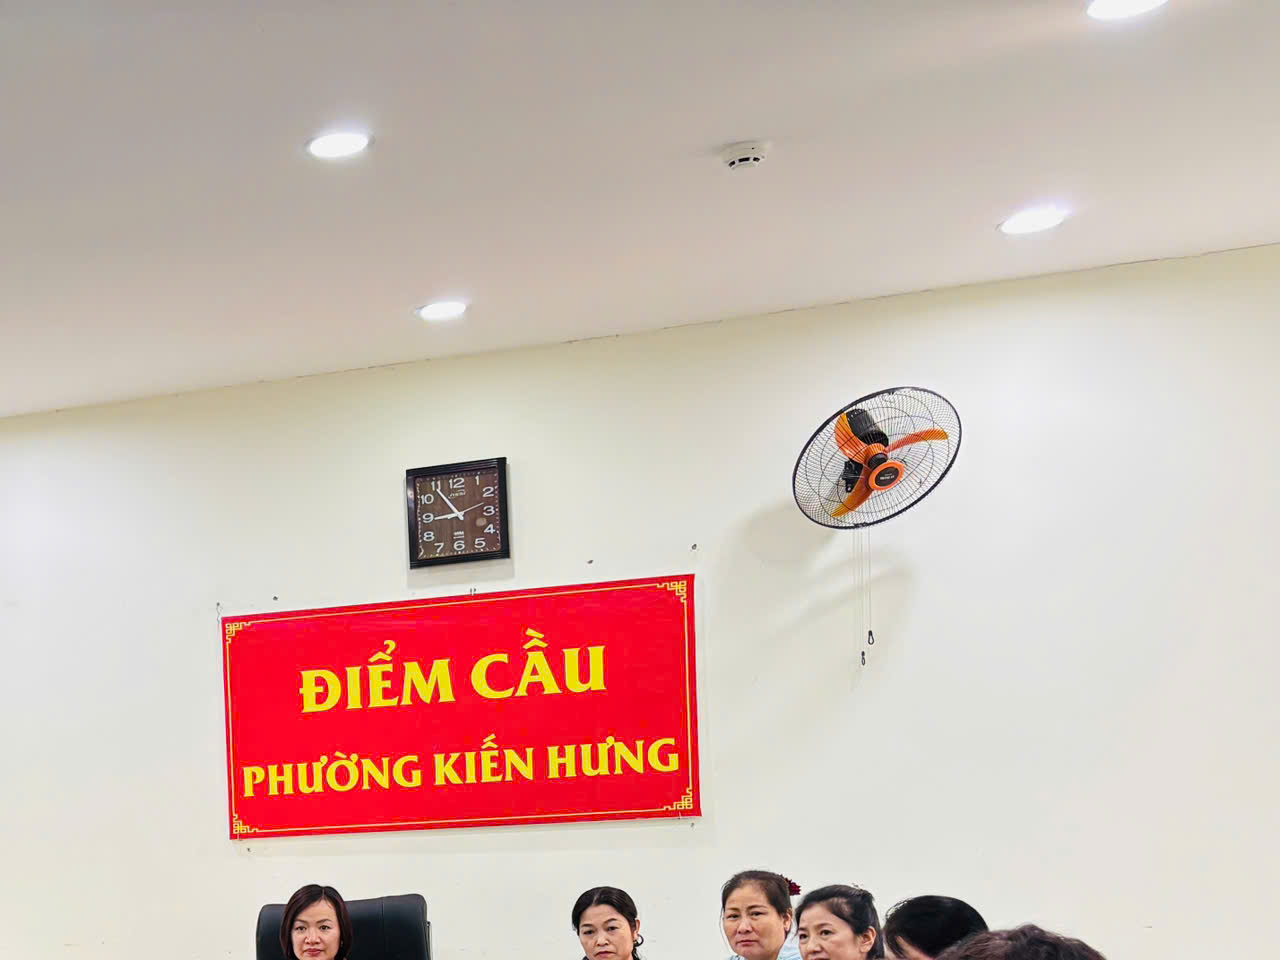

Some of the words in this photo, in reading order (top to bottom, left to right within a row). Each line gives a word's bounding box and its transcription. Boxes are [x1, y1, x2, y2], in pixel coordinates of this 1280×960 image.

[431, 480, 441, 491] 11
[448, 477, 465, 489] 12
[482, 486, 494, 498] 2
[420, 493, 434, 505] 10
[483, 505, 495, 516] 3
[422, 512, 434, 523] 9
[484, 523, 495, 534] 4
[423, 531, 435, 542] 8
[434, 542, 444, 553] 7
[453, 540, 465, 551] 6
[474, 537, 486, 549] 5
[300, 639, 456, 713] ĐIỂM
[471, 628, 606, 699] CẦU
[243, 750, 422, 797] PHƯỜNG
[434, 734, 533, 785] KIẾN
[547, 736, 680, 779] HƯNG
